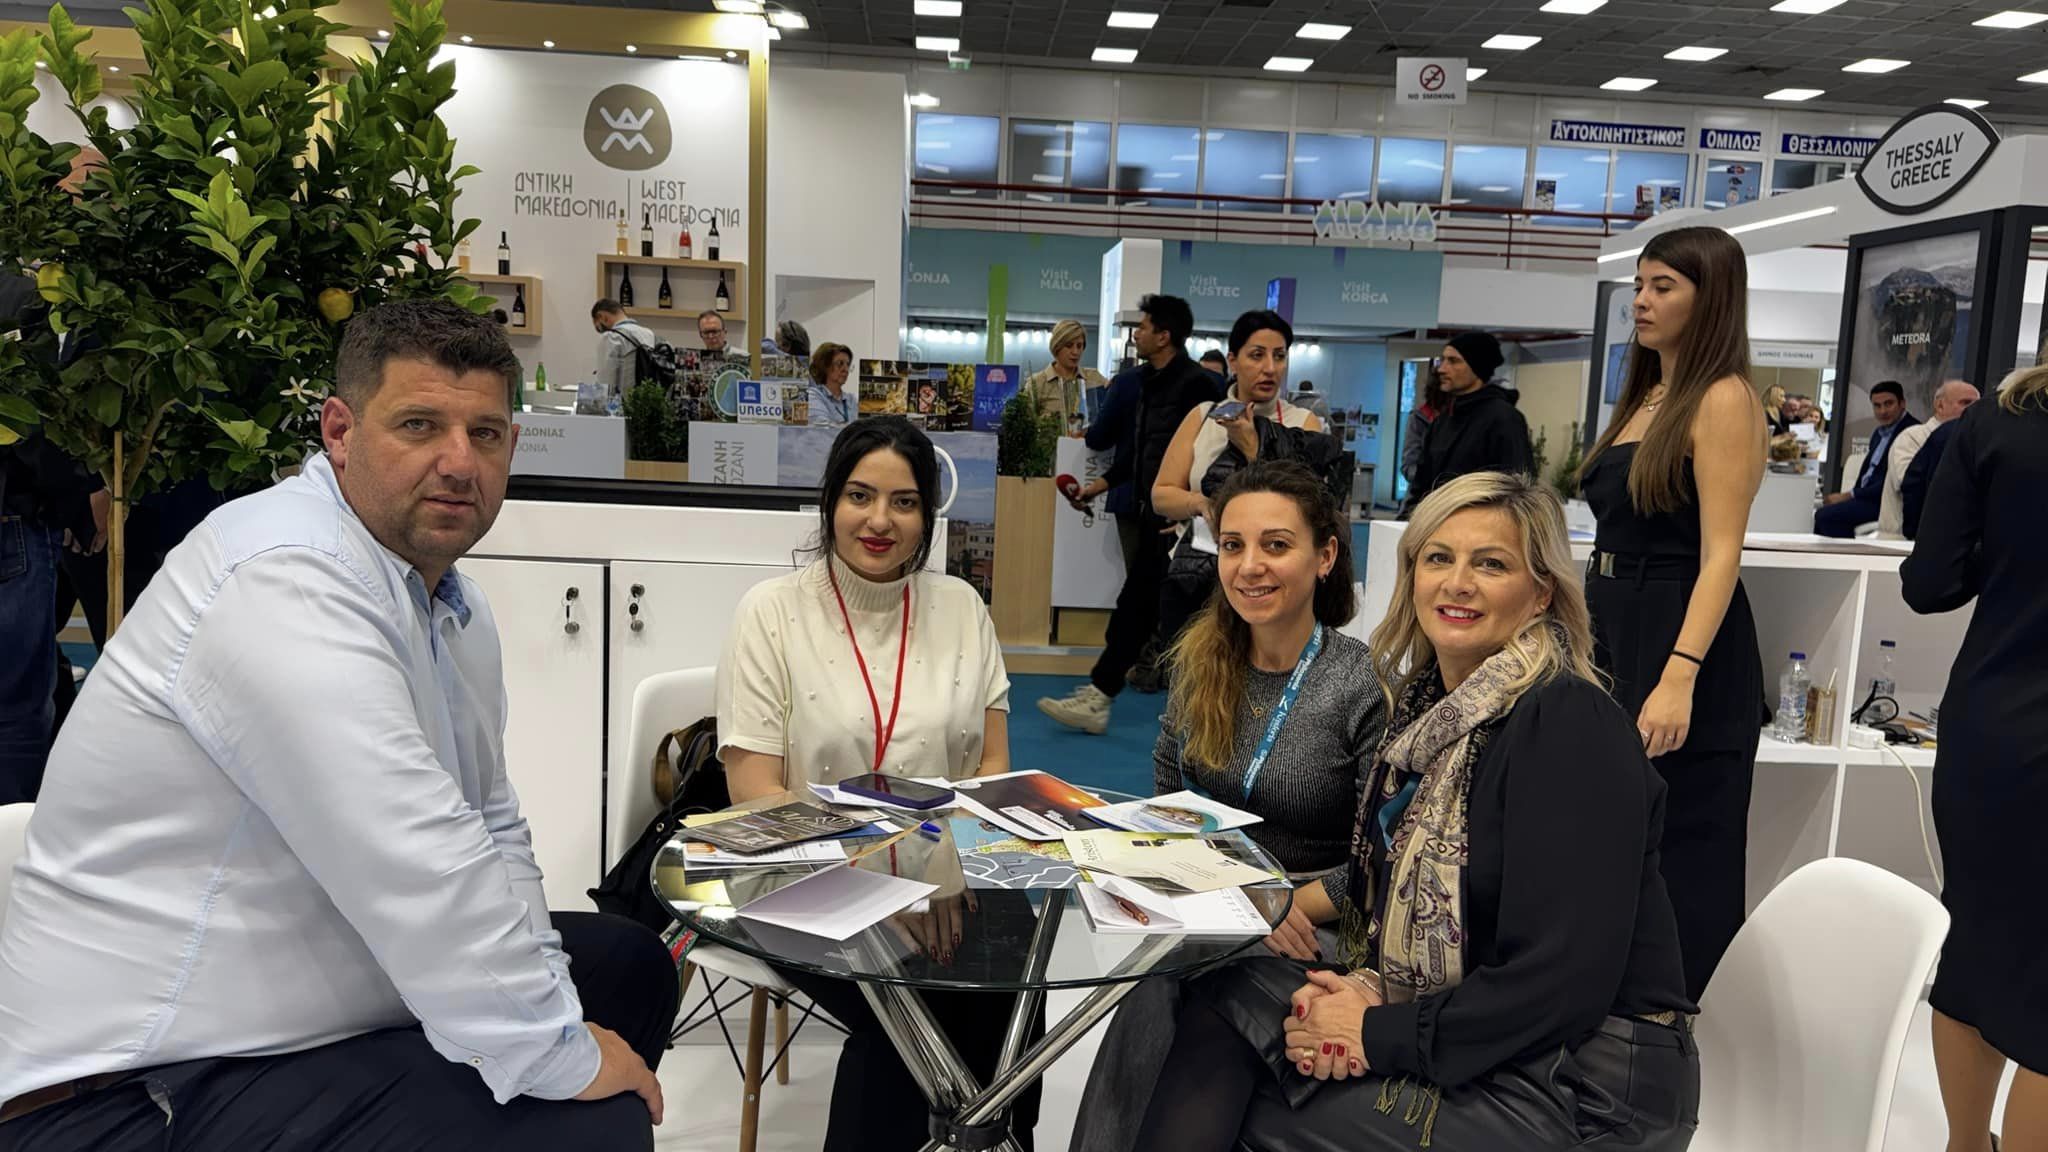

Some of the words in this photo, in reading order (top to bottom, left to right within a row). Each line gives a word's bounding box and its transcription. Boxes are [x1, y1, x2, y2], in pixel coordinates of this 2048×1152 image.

[1706, 130, 1761, 150] ΟΜΙΛΟΣ
[1788, 135, 1879, 158] ΘΕΣΣΑΛΟΝΙΚ
[1886, 131, 1964, 169] THESSALY
[515, 171, 573, 194] ΔΥΤΙΚΗ
[1891, 158, 1952, 189] GREECE
[641, 179, 686, 201] WEST
[515, 195, 617, 220] ΜΑΚΕΔΟΝΙΑ
[641, 202, 741, 228] MACEDONIA
[1041, 268, 1069, 280] Visit
[1189, 274, 1218, 286] Visit
[1188, 285, 1240, 297] PUSTEC
[1343, 281, 1371, 293] Visit
[1891, 332, 1931, 345] METEORA
[738, 404, 782, 417] unesco
[714, 440, 727, 483] ΖΑΝΗ
[731, 441, 744, 484] OZANI
